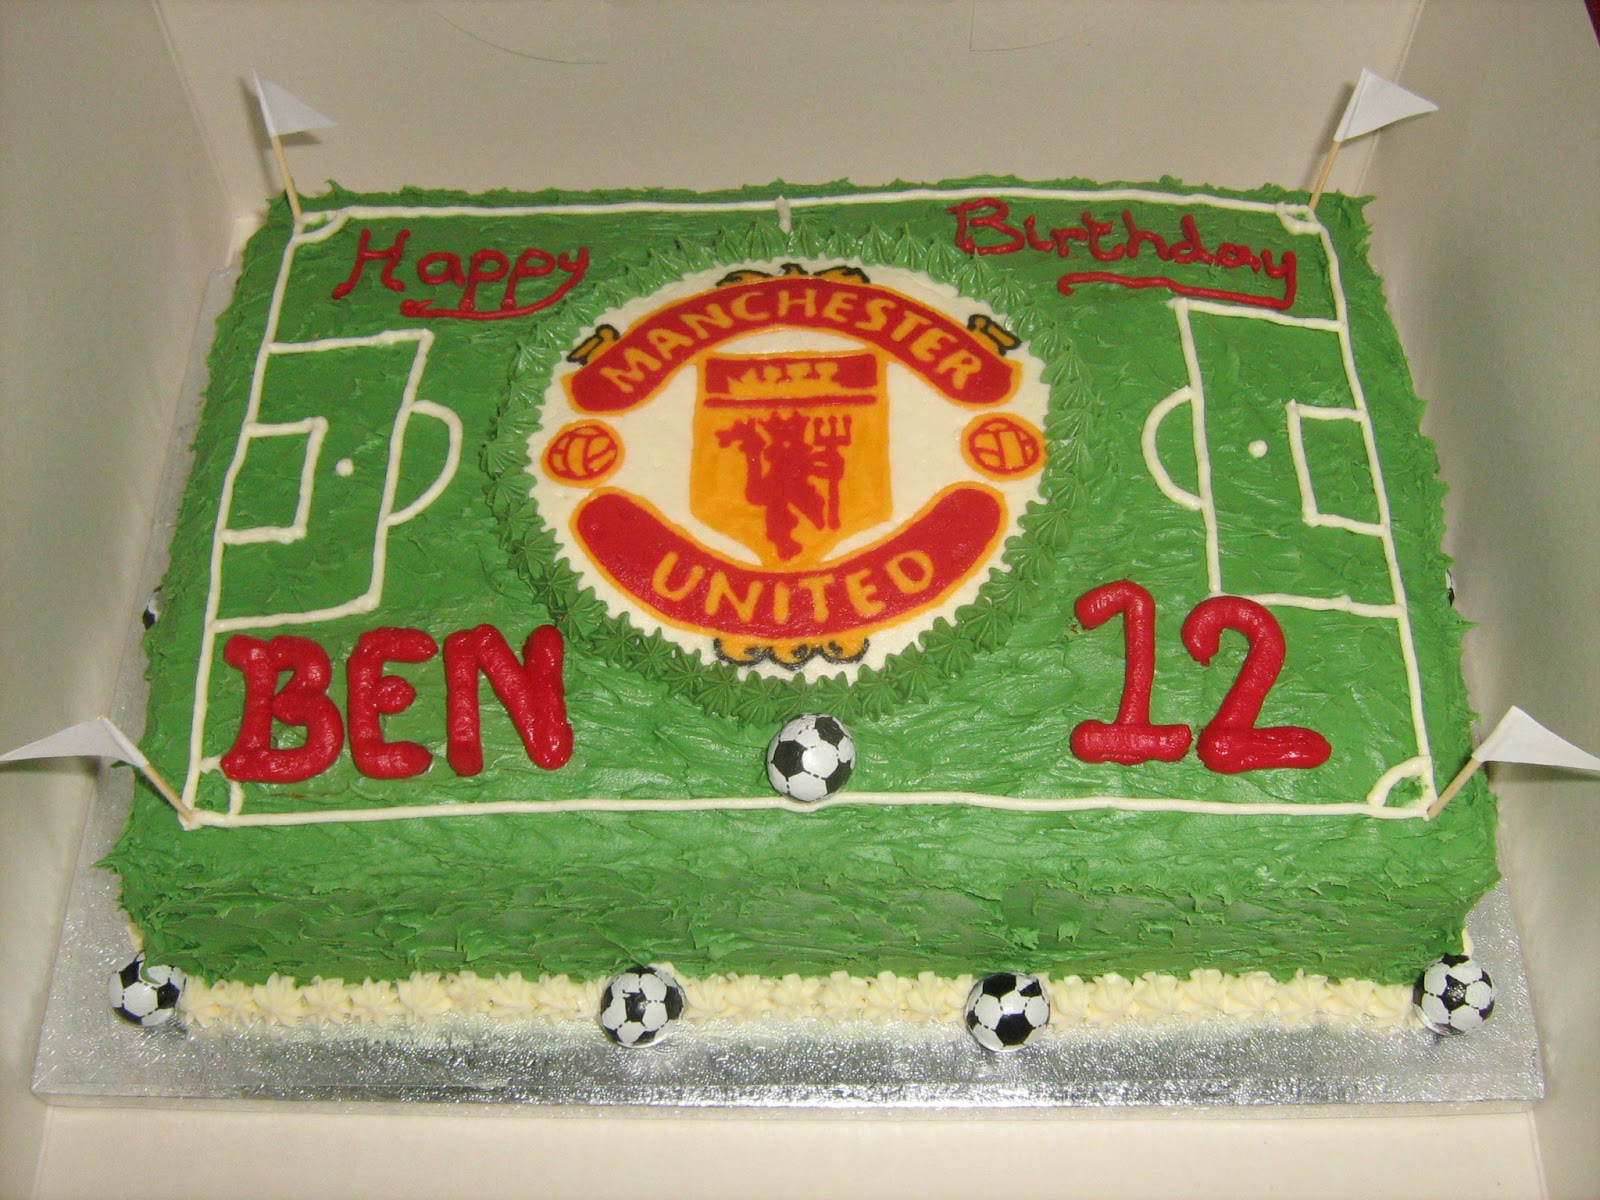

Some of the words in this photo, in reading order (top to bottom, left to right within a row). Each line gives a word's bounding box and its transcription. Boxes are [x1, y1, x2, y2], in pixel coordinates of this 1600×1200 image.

[332, 228, 589, 320] Happy
[947, 197, 1296, 310] Birthday
[600, 288, 984, 394] MANCHESTER
[651, 549, 935, 624] UNITED
[220, 623, 574, 783] BEN
[1070, 579, 1332, 774] 12
